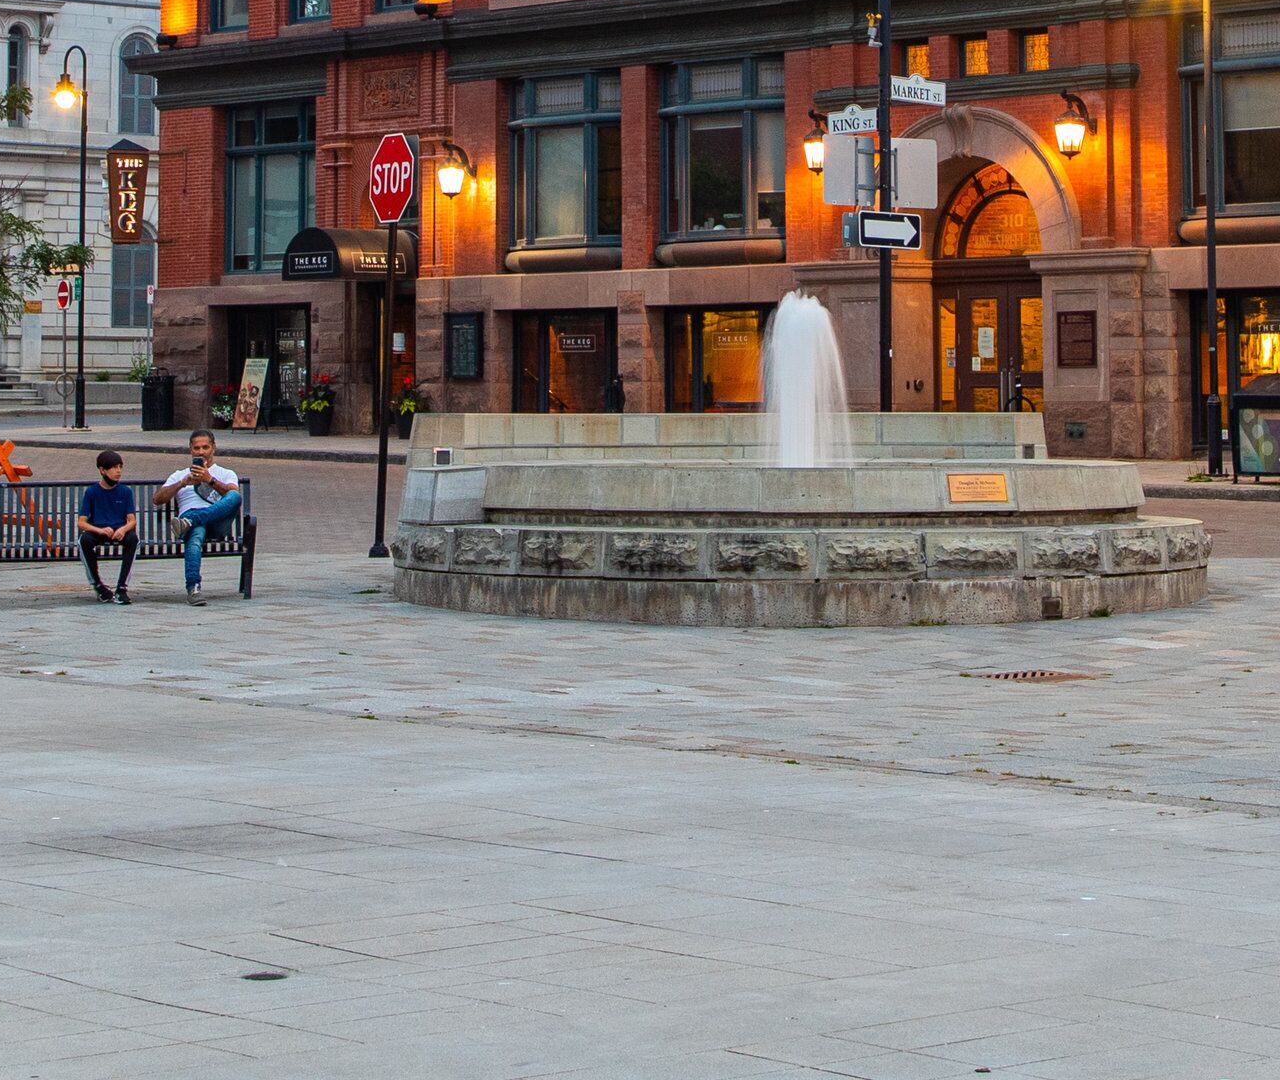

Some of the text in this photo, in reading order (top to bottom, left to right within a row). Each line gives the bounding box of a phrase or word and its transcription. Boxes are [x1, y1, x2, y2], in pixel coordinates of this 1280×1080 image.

[893, 84, 943, 102] MARKET ST.
[832, 118, 874, 132] KING ST.
[373, 162, 410, 195] STOP
[118, 170, 139, 233] KEG
[999, 213, 1024, 228] 310
[294, 256, 328, 265] THE KEG
[360, 256, 377, 264] THE
